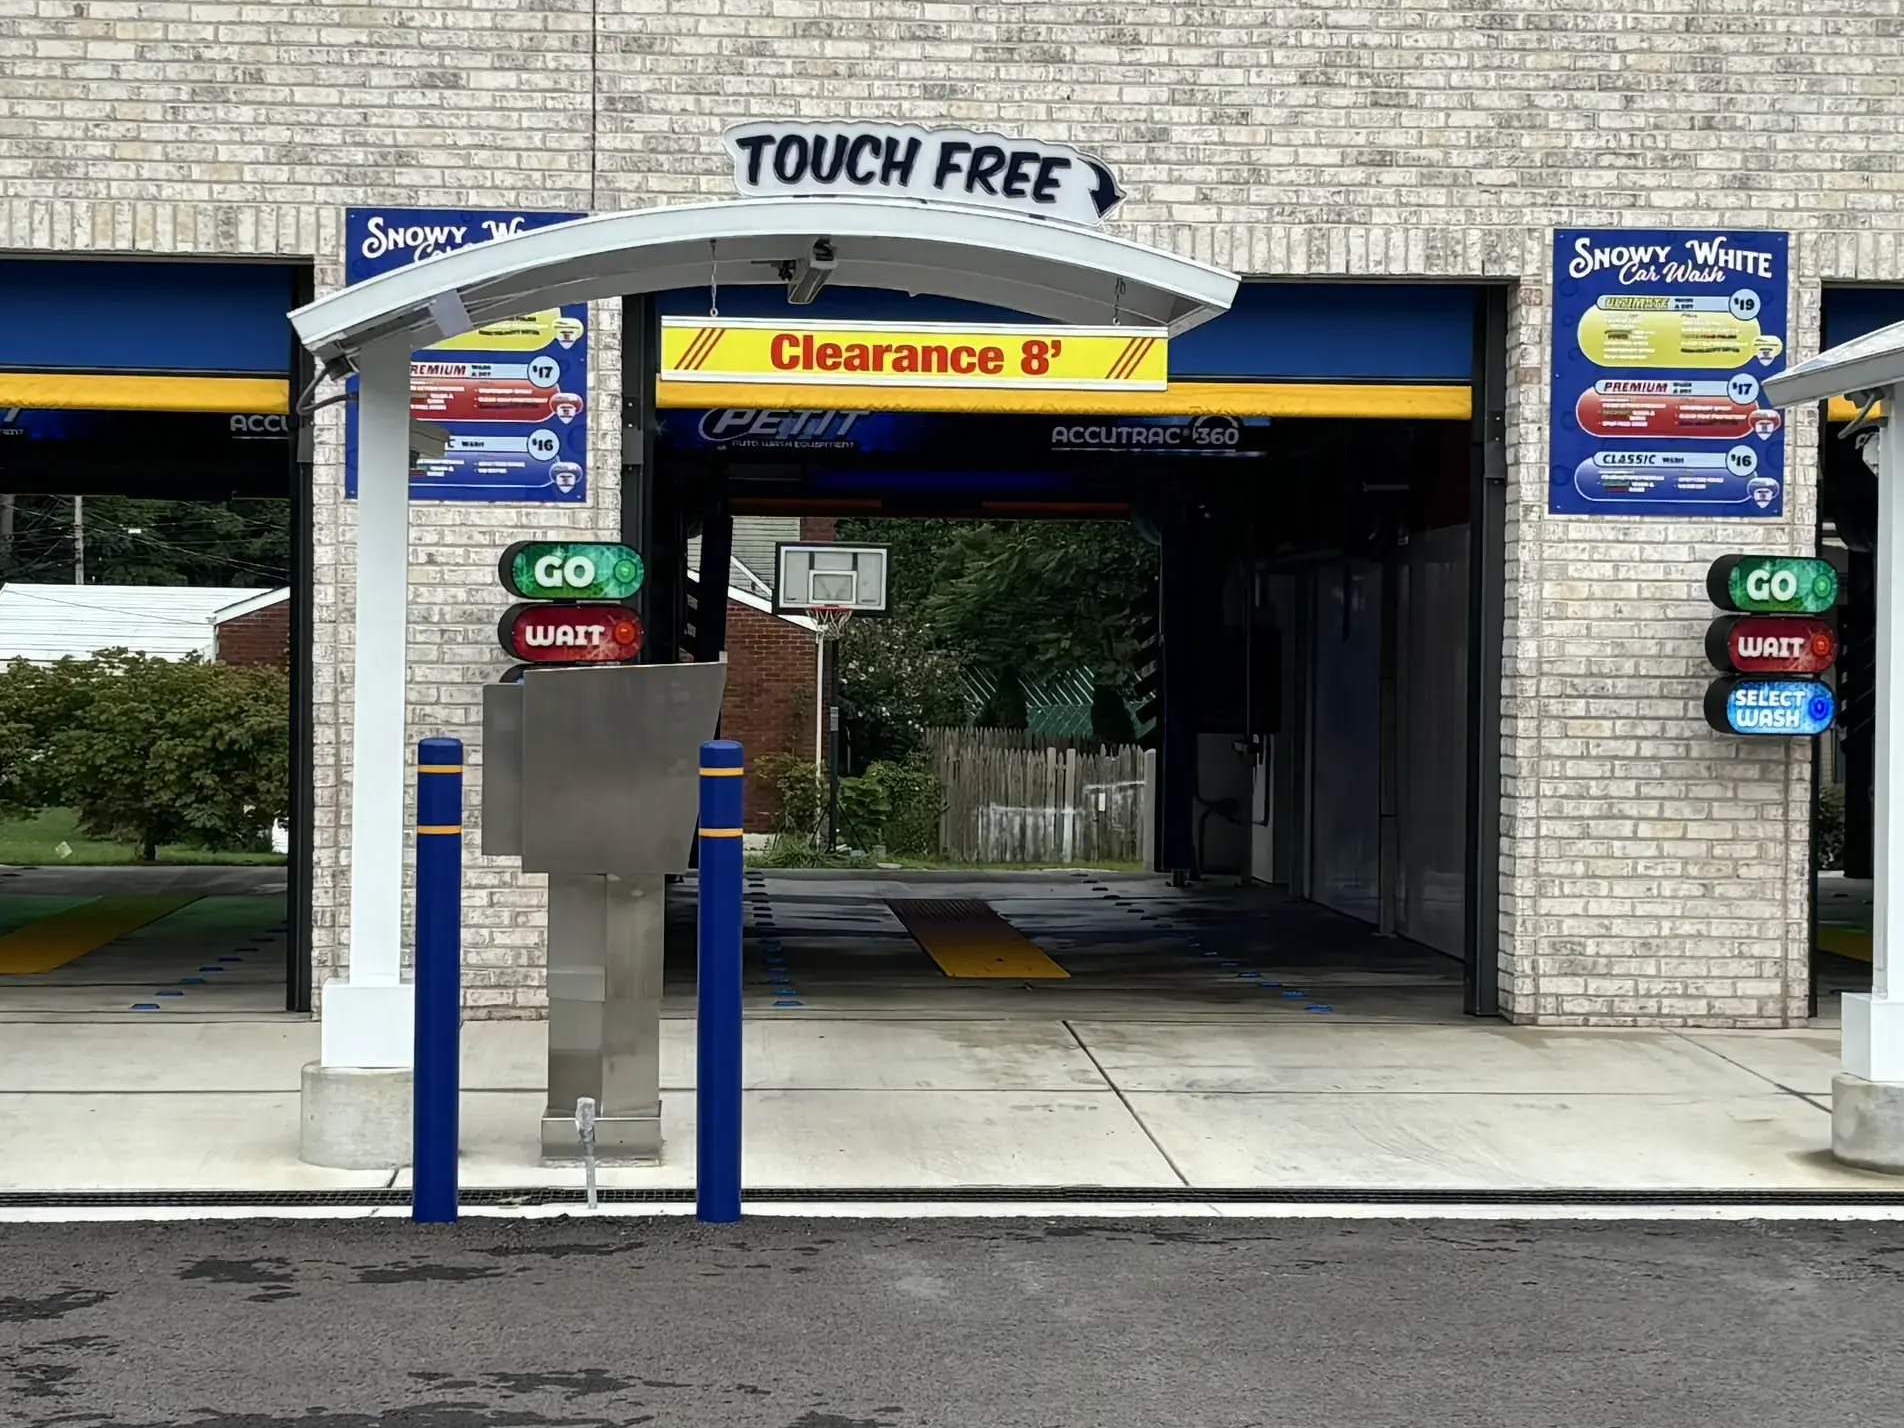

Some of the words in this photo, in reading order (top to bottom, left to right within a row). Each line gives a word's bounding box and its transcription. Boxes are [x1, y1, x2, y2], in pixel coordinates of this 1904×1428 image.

[734, 133, 922, 187] TOUCH
[933, 141, 1072, 204] FREE
[362, 216, 467, 259] SNOWY
[1569, 237, 1671, 278] SNOWY
[1685, 236, 1773, 279] WHITE
[1618, 262, 1660, 285] Car
[1662, 260, 1726, 283] Wash
[1734, 297, 1755, 311] $19
[770, 333, 1005, 375] Clearance
[1020, 339, 1062, 375] 8'
[411, 364, 466, 376] REMIUM
[532, 365, 553, 379] $17
[1604, 381, 1668, 393] PREMIUM
[1732, 381, 1753, 395] $17
[712, 409, 870, 435] PETIT
[532, 438, 554, 452] $16
[1051, 426, 1181, 444] ACCUTRAC
[1196, 427, 1240, 445] 360
[1602, 454, 1656, 465] CLASSIC
[1731, 453, 1752, 467] $16
[534, 555, 595, 588] GO
[1746, 569, 1797, 602] GO
[525, 625, 605, 647] WAIT
[1737, 636, 1805, 658] WAIT
[1735, 689, 1806, 707] SELECT
[1736, 709, 1800, 728] WASH
